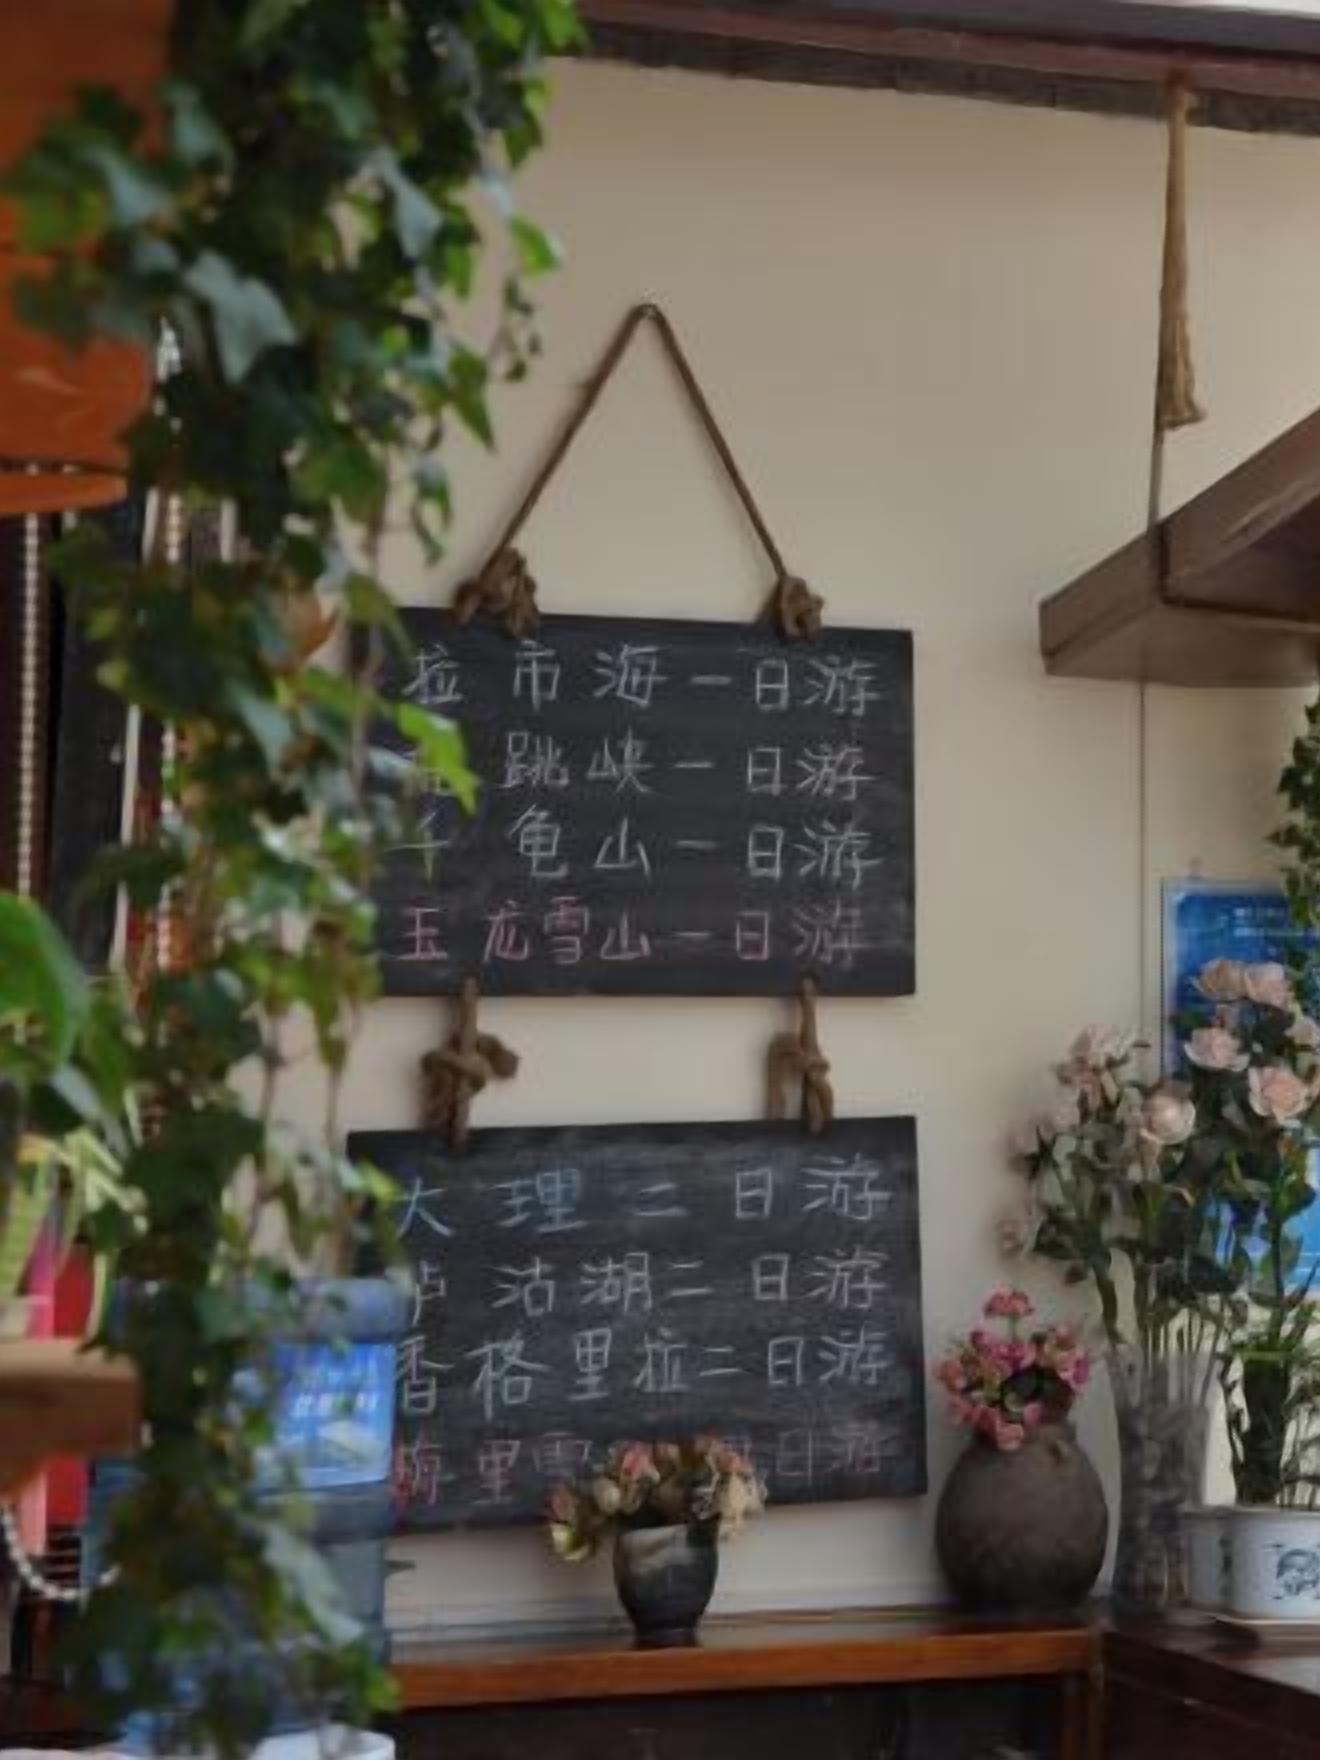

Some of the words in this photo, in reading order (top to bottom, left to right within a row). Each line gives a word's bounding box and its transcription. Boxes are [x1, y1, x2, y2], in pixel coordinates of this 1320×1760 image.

[405, 638, 881, 715] 拉市海一日游
[385, 897, 878, 967] 玉龙雪山一日游
